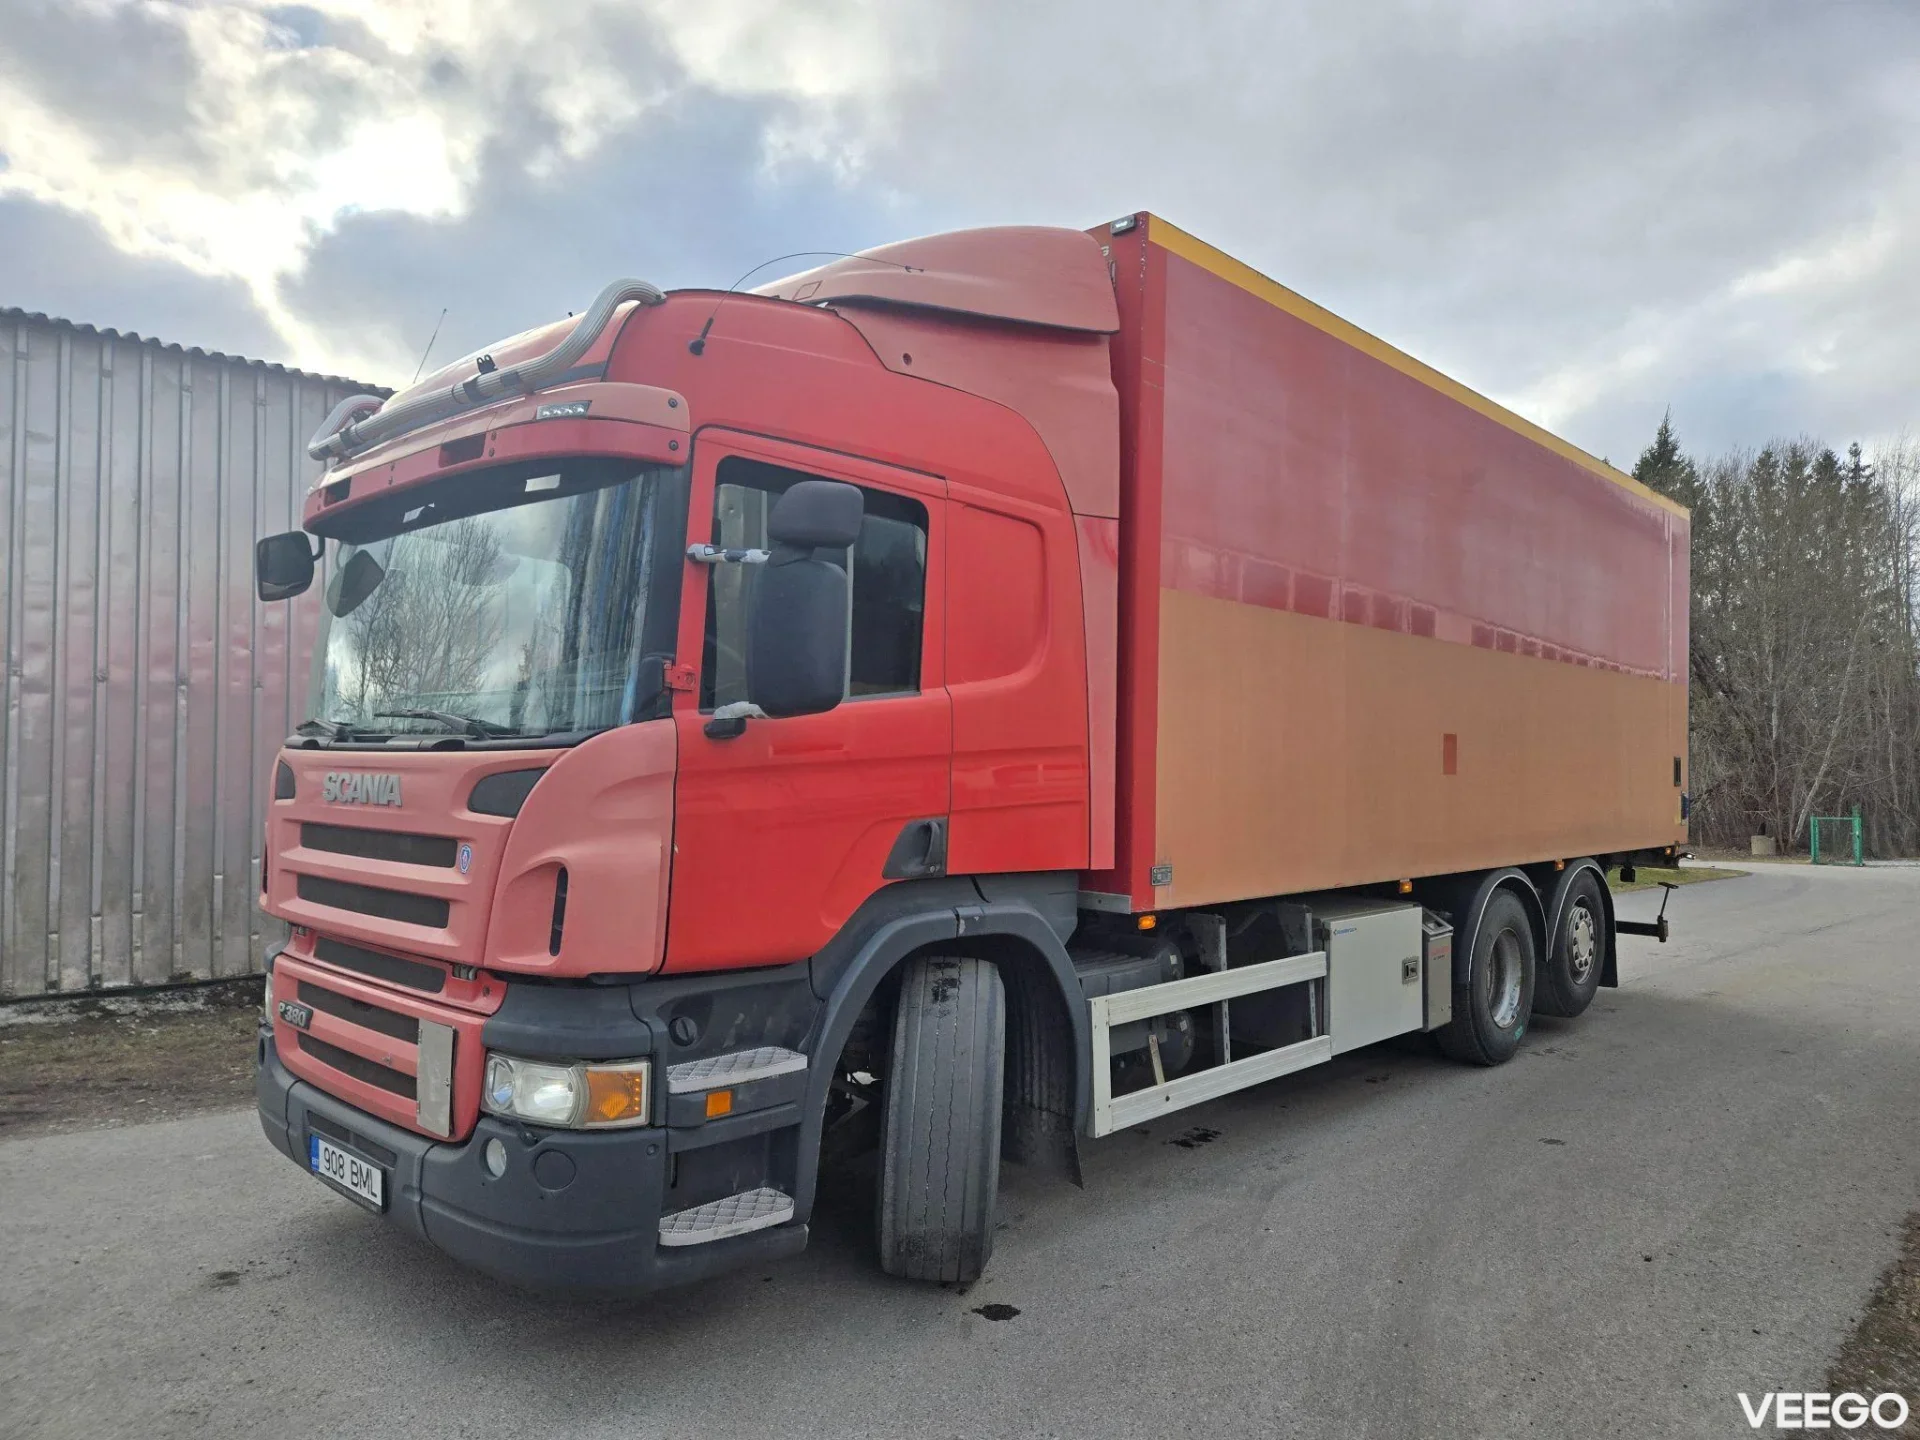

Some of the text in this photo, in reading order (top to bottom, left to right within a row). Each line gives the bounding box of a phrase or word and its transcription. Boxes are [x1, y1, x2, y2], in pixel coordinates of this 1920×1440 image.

[322, 771, 402, 807] SCANIA
[323, 1147, 345, 1180] 908
[350, 1159, 378, 1198] BML
